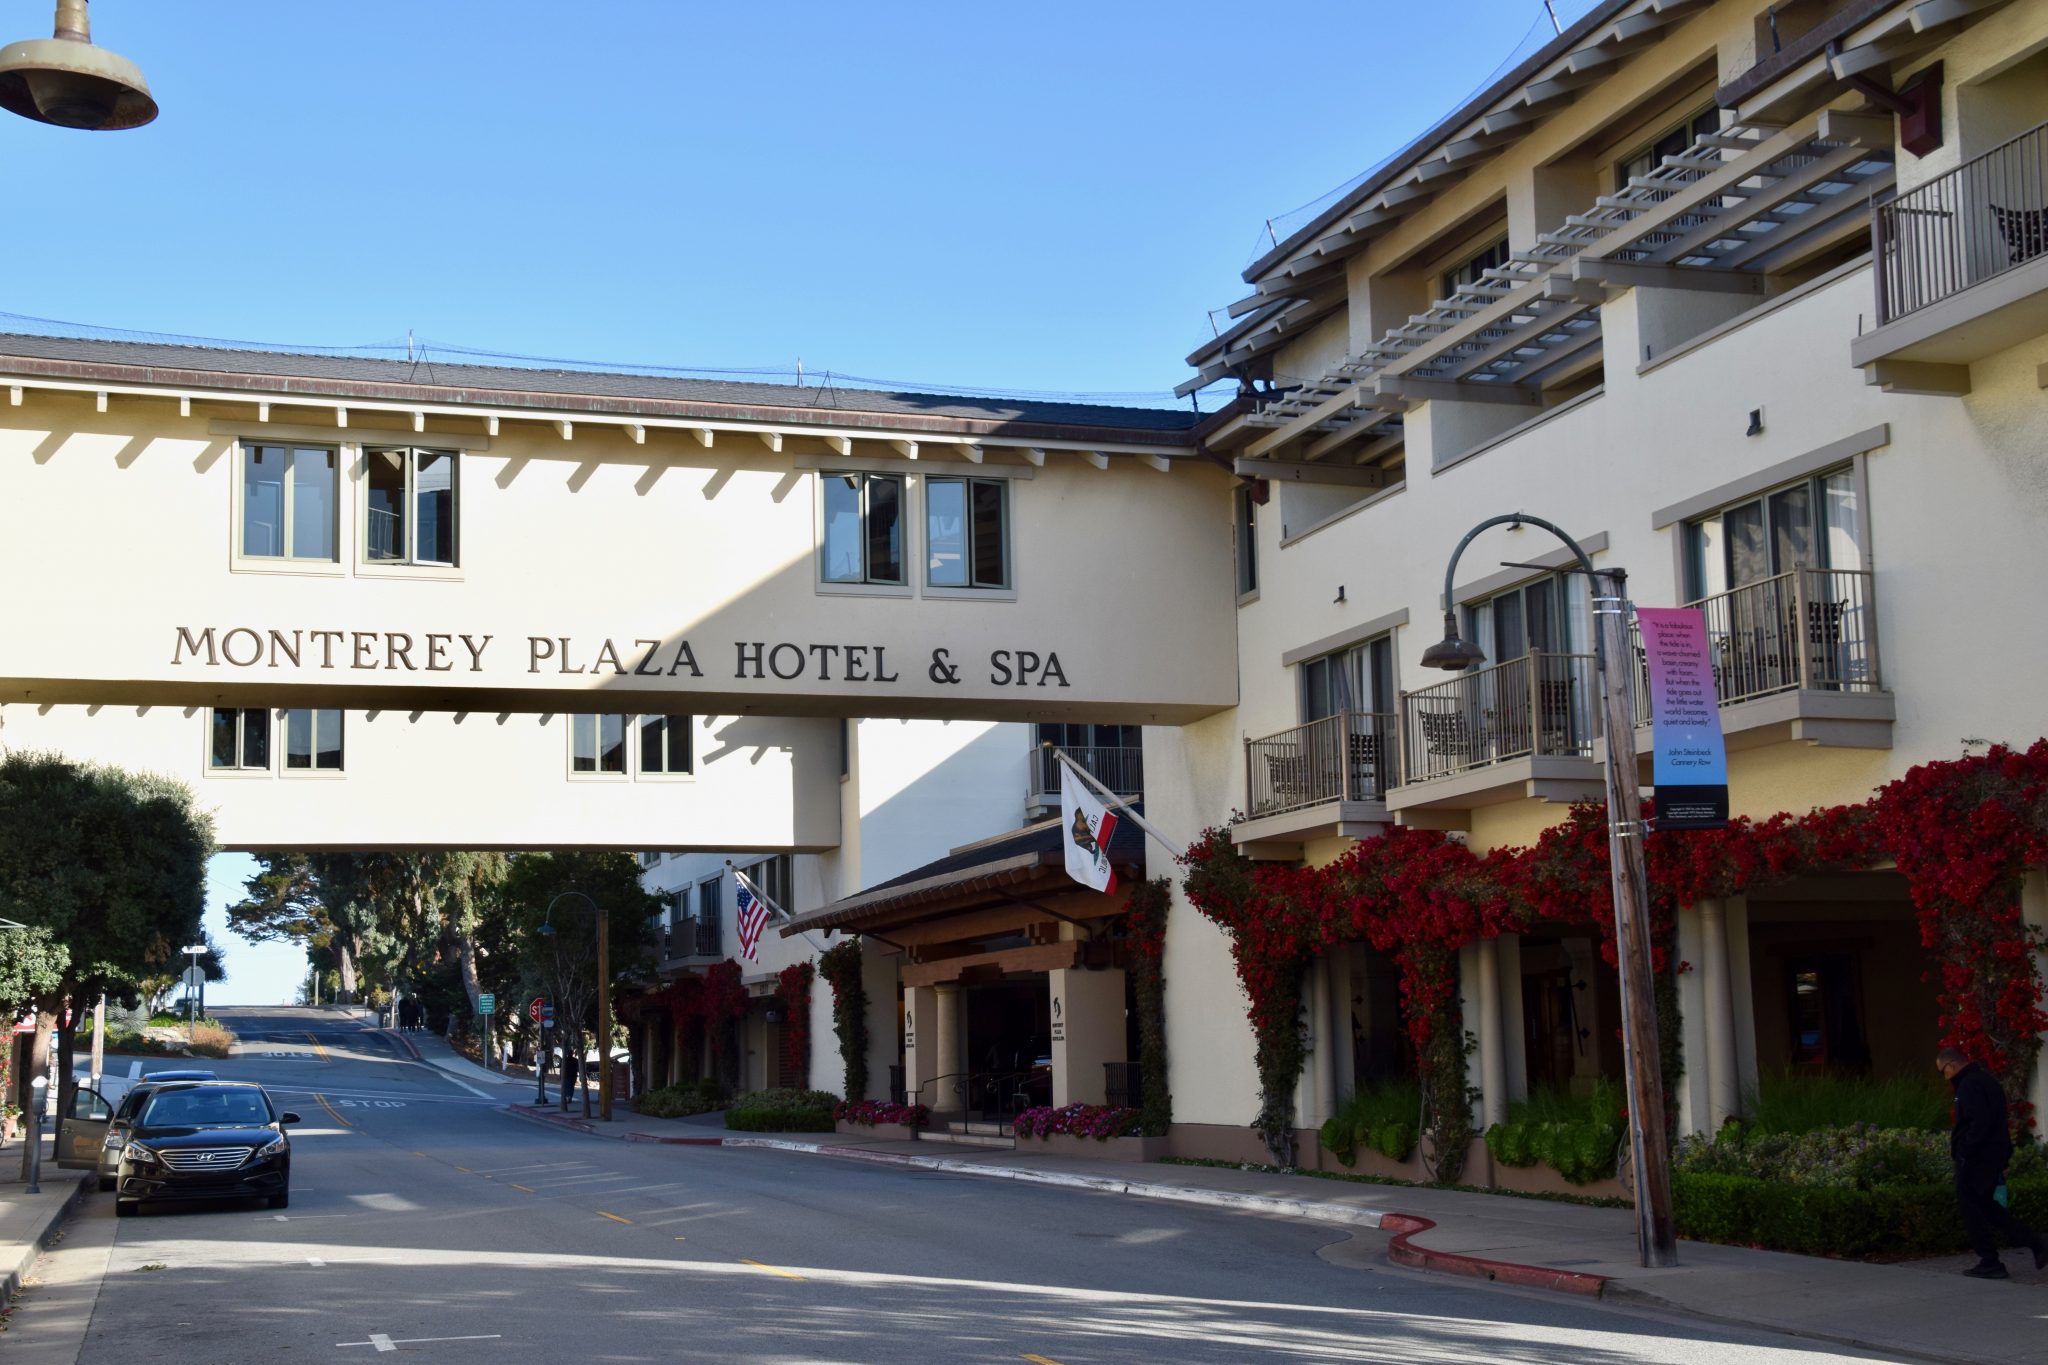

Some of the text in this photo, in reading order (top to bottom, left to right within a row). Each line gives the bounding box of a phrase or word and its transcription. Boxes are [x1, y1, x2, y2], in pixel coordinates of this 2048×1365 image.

[170, 626, 1070, 687] MONTEREY PLAZA HOTEL & SPA
[1664, 707, 1681, 715] world
[1679, 717, 1690, 725] and
[1671, 758, 1711, 767] Cannery Row
[339, 1100, 407, 1108] STOP
